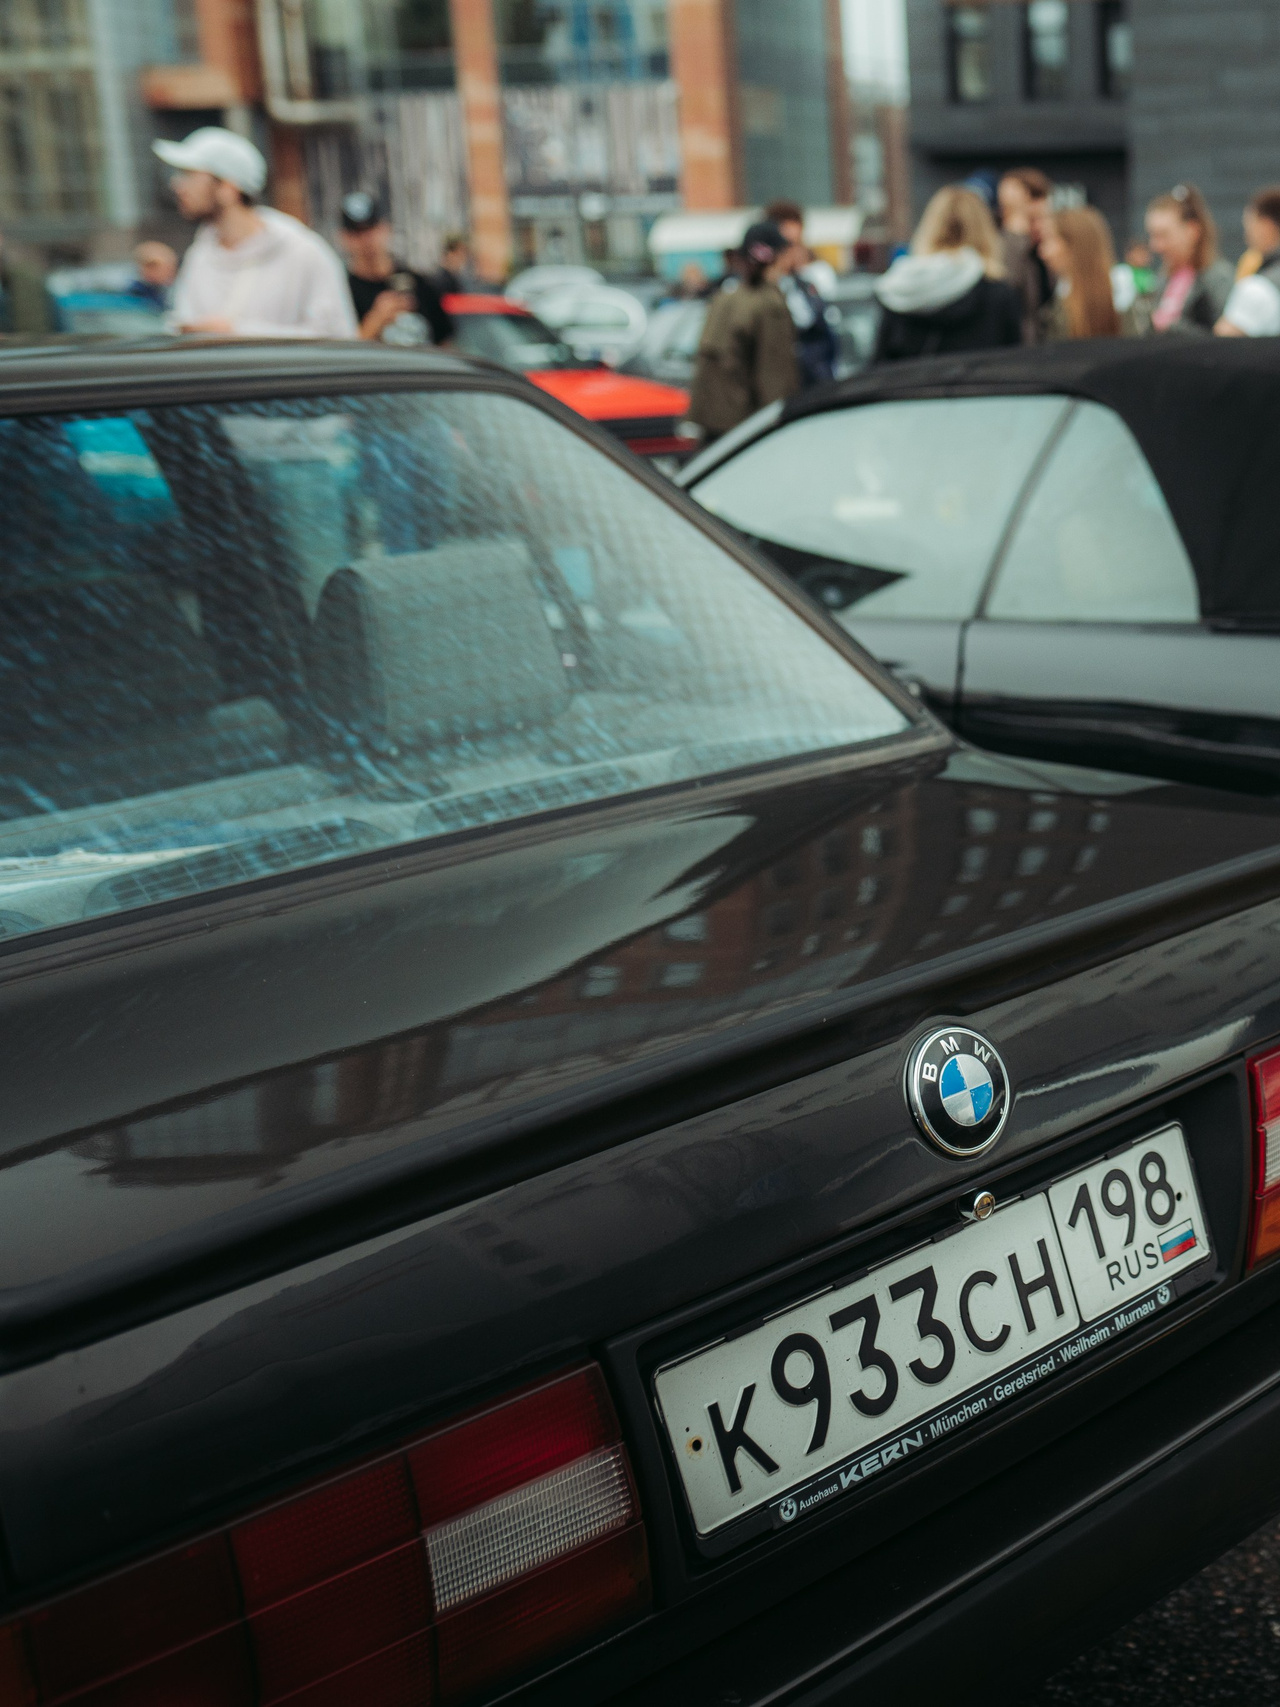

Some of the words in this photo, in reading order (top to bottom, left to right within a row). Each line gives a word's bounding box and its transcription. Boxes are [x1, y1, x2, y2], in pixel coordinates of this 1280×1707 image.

[922, 1036, 992, 1083] BMW
[1068, 1151, 1176, 1259] 198
[1106, 1242, 1159, 1291] RUS
[799, 1483, 839, 1511] Autohaus
[839, 1430, 924, 1490] KERN
[929, 1397, 989, 1439] München
[993, 1356, 1056, 1402] Geretsried
[1059, 1325, 1111, 1363] Weilheim
[1114, 1299, 1156, 1332] Murnau
